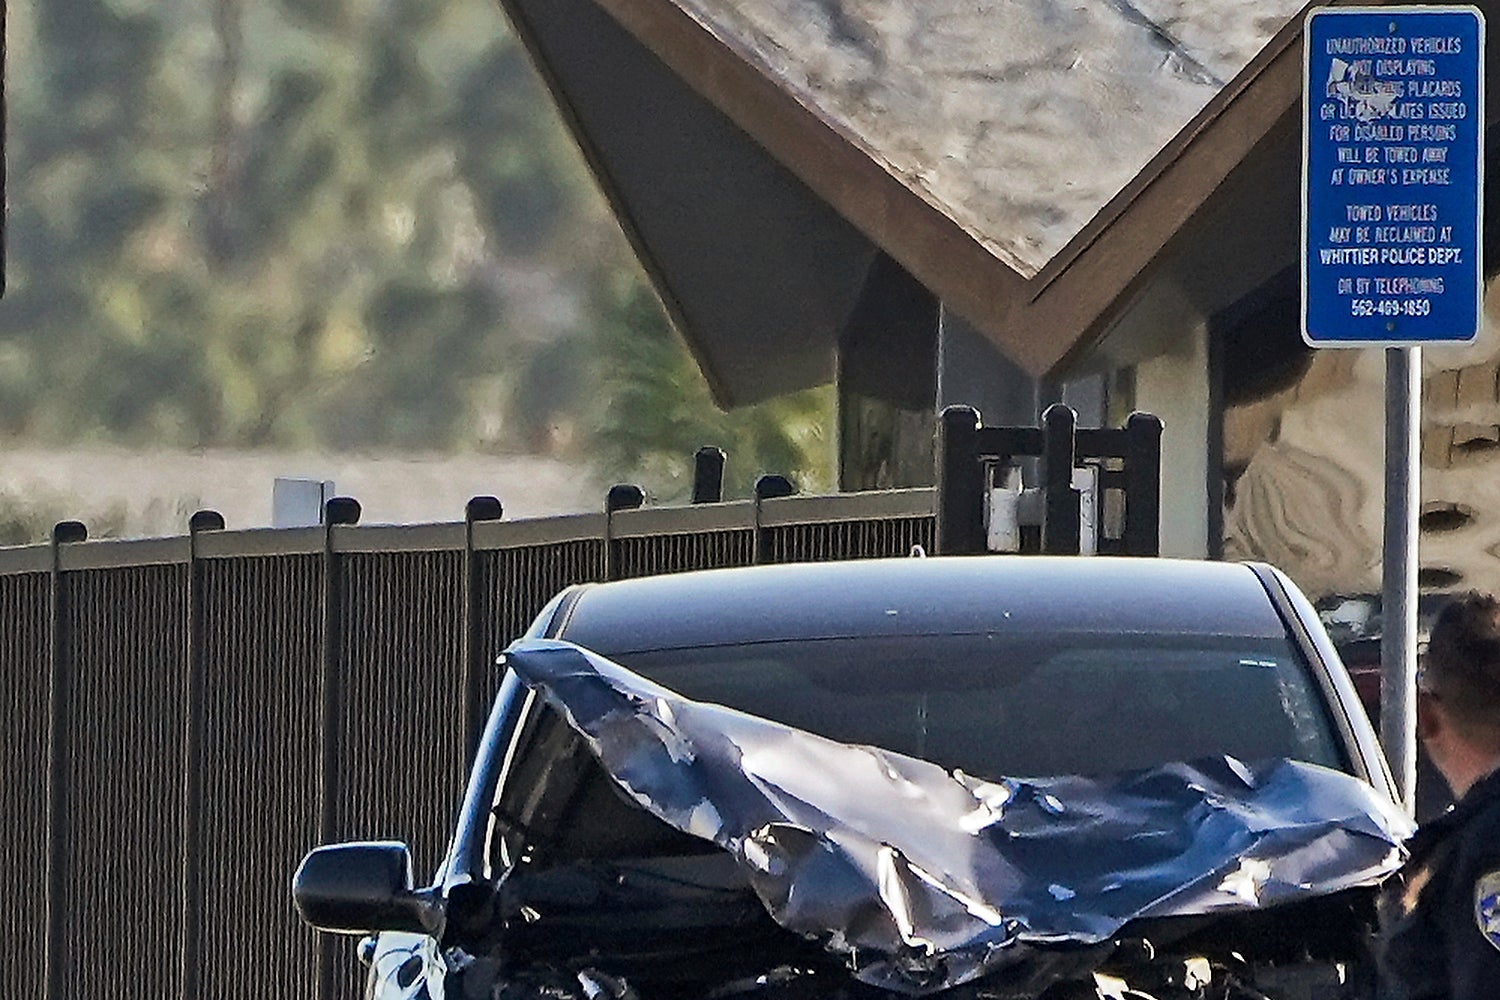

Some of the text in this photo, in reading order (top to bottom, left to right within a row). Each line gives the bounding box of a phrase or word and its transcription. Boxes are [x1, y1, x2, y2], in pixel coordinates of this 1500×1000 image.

[1326, 38, 1462, 54] UNAUTHORIZED VEHICLES
[1376, 60, 1436, 76] DISPLAYING
[1408, 81, 1462, 97] PLACARDS
[1320, 103, 1336, 120] OR
[1428, 103, 1466, 119] ISSUED
[1330, 125, 1456, 141] FOR DISABLED PERSONS
[1337, 147, 1448, 163] WILL BE TOWED AWAY
[1331, 169, 1344, 184] AT
[1349, 169, 1398, 184] OWNER'S
[1346, 205, 1437, 221] TOWED VEHICLES
[1329, 227, 1452, 243] MAY BE RECLAIMED AT
[1320, 248, 1462, 265] WHITTIER POLICE DEPT.
[1338, 278, 1445, 294] OR BY TELEPHONING
